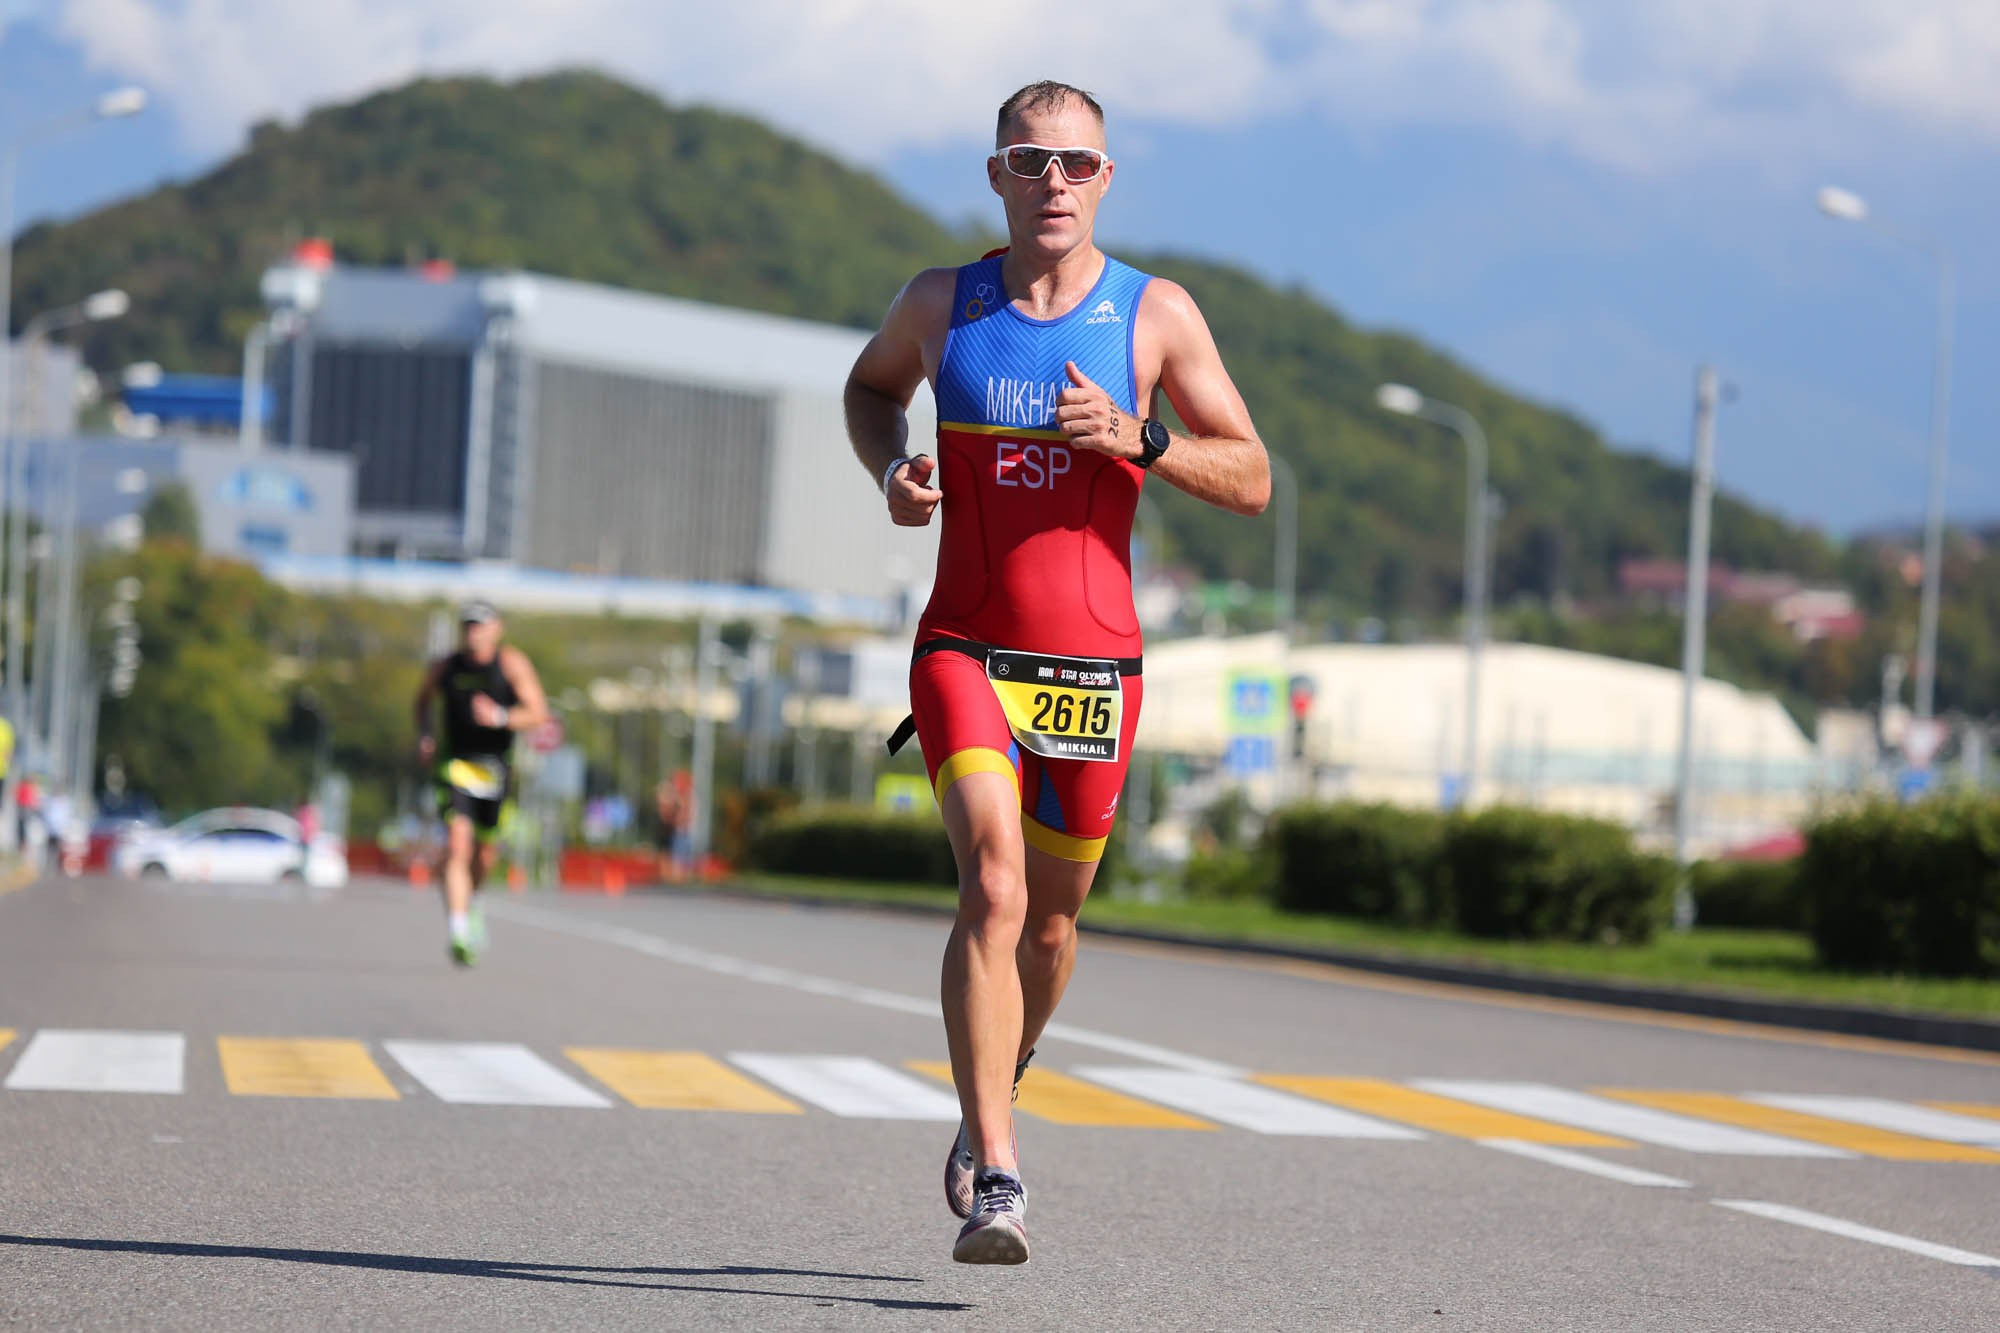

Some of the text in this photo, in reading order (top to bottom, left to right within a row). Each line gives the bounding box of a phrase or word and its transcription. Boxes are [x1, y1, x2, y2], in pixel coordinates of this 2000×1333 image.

[986, 376, 1073, 426] MIKHA
[996, 442, 1072, 490] ESP
[1038, 666, 1055, 678] IRON
[1061, 669, 1078, 681] STAR
[1031, 691, 1112, 735] 2615
[1057, 742, 1108, 755] MIKHAIL
